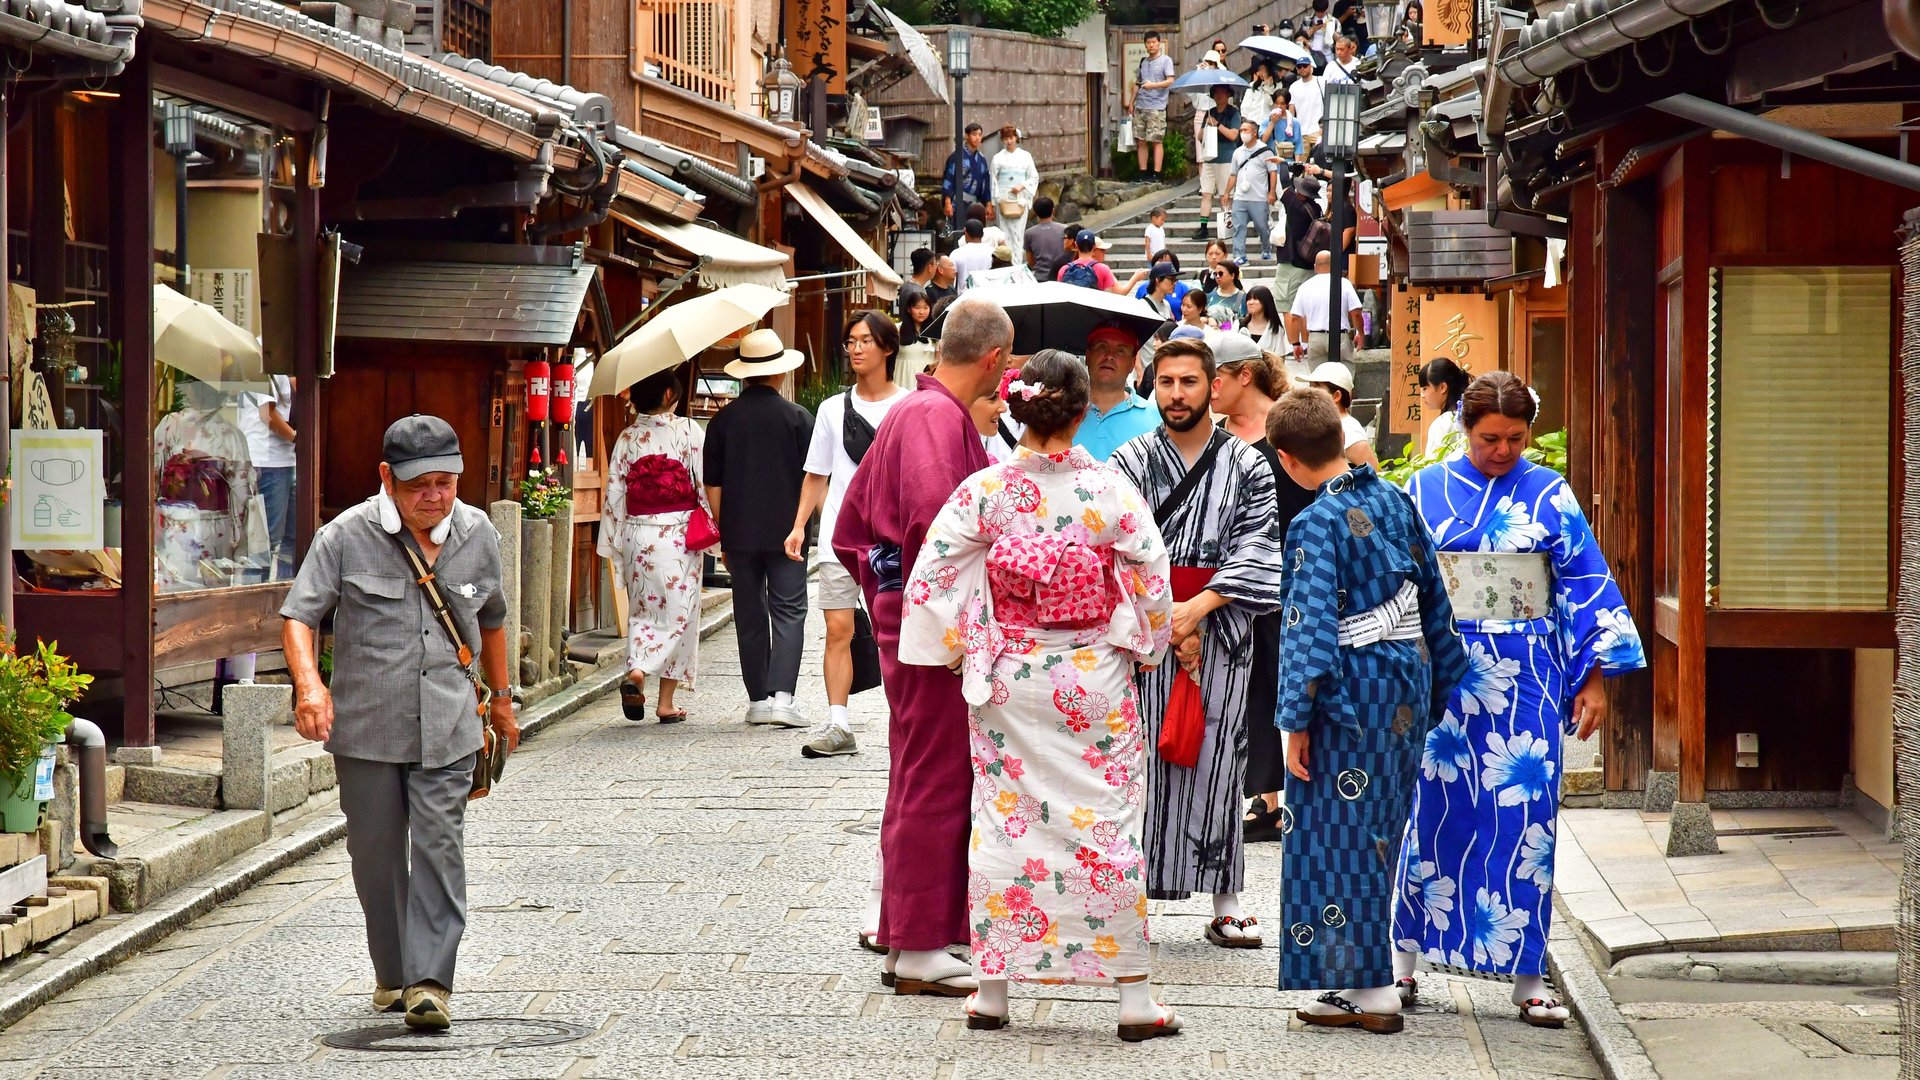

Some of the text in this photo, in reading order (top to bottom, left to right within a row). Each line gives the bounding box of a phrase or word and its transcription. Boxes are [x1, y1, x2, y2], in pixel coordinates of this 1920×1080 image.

[813, 15, 840, 51] Kyoto
[1405, 296, 1421, 421] 神田竹細工店
